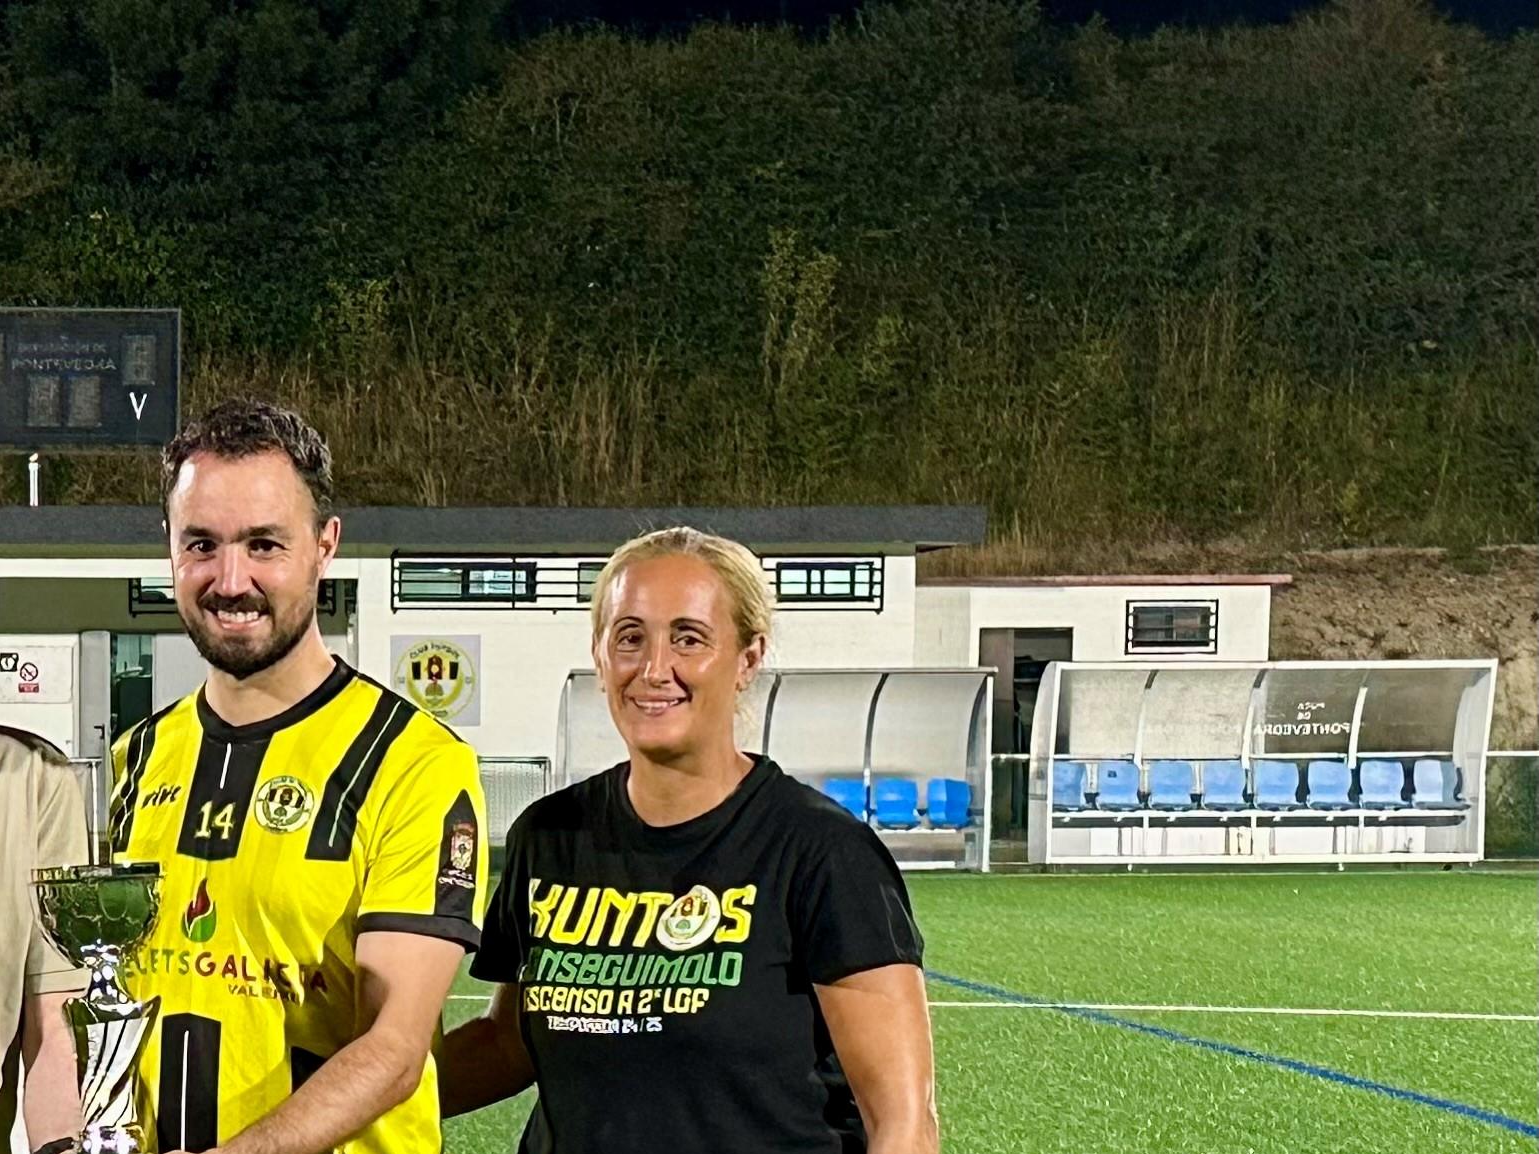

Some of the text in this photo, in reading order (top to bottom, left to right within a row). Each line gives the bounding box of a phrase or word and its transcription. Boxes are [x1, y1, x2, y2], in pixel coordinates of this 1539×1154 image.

[129, 391, 148, 421] V
[193, 799, 236, 840] 14
[617, 989, 635, 1015] A
[662, 988, 710, 1014] LGF
